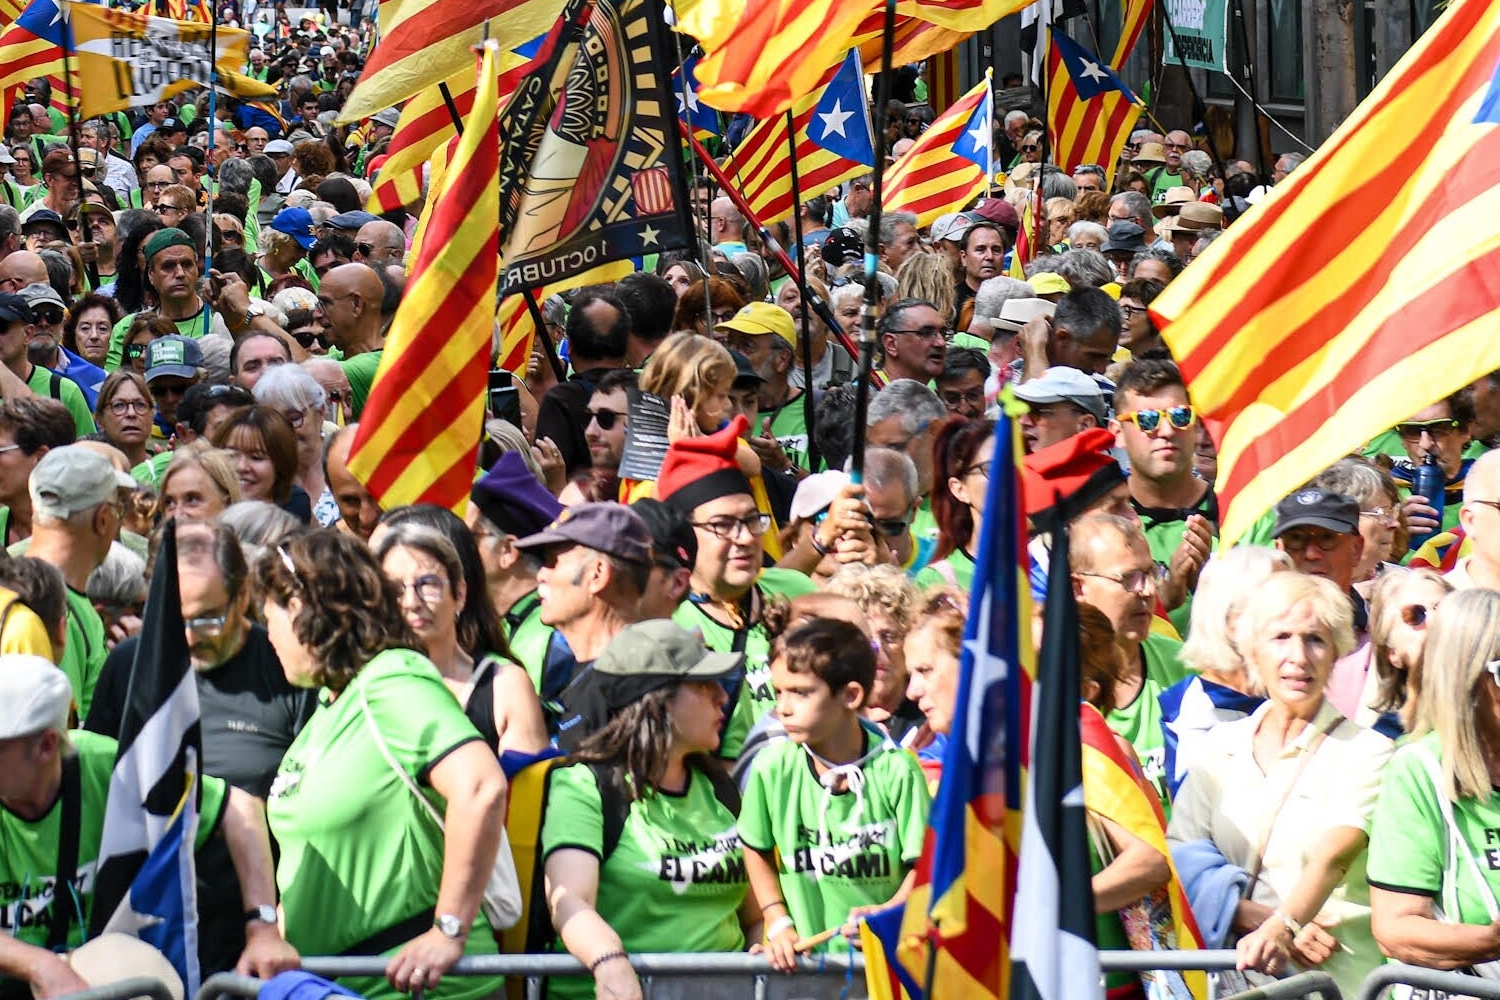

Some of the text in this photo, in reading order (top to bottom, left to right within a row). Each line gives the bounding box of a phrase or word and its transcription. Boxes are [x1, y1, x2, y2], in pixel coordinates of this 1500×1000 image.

[499, 75, 543, 194] CATALAN
[658, 852, 747, 884] EL CAM
[794, 845, 816, 873] EL
